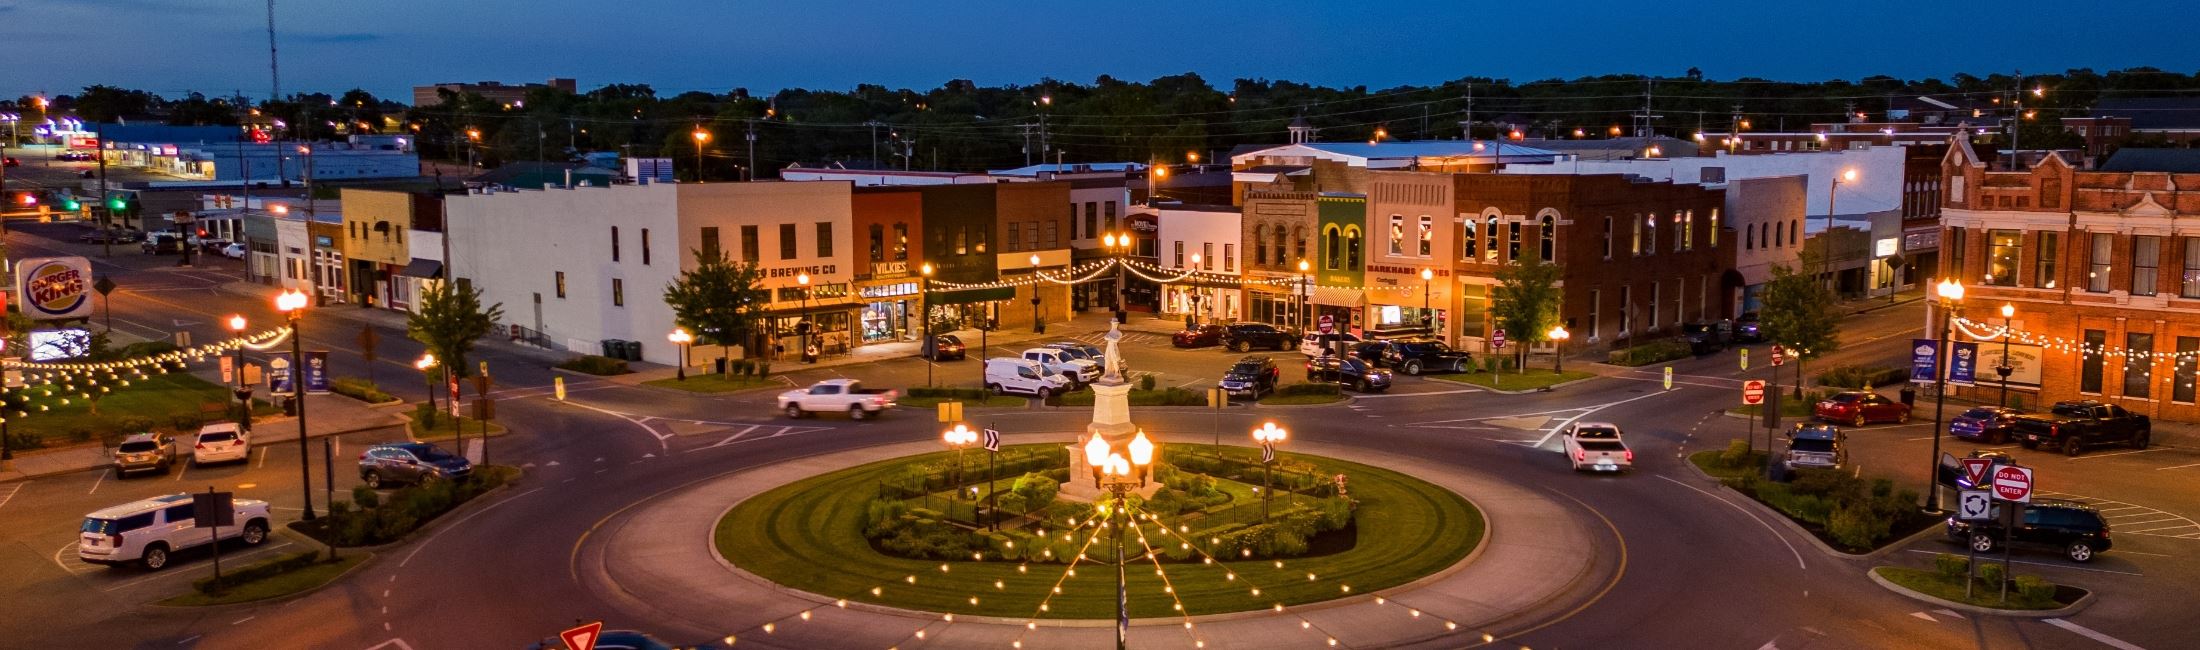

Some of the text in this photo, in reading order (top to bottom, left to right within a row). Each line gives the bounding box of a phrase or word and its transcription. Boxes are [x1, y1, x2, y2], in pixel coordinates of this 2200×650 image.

[770, 266, 819, 278] BREWING
[822, 265, 836, 275] CO
[875, 262, 907, 274] VILKIES
[1367, 265, 1416, 275] MARKHAMS
[31, 270, 79, 291] BURGER
[35, 280, 82, 305] KING
[2001, 487, 2022, 495] ENTER
